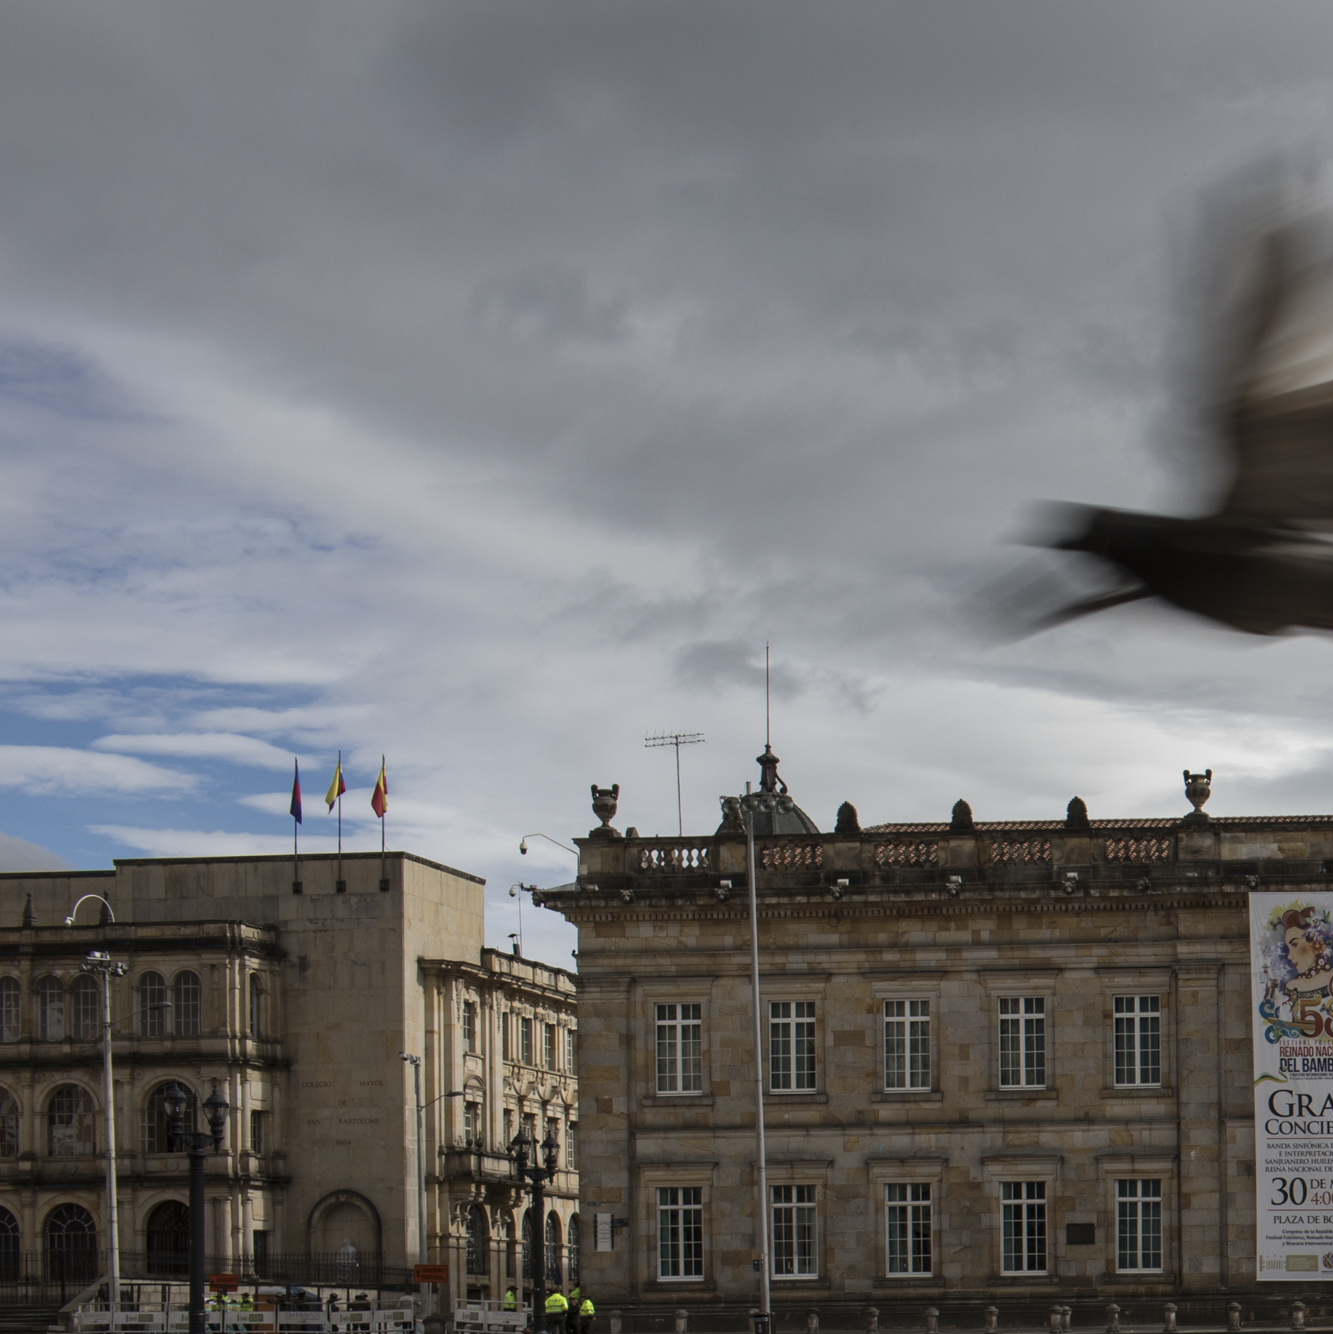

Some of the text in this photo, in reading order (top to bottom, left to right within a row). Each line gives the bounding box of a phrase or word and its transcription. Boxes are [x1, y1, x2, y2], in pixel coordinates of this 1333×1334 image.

[1279, 1046, 1314, 1057] REINADO
[1280, 1058, 1300, 1073] DEL
[1292, 1141, 1329, 1149] SINFÓNICA
[1271, 1177, 1307, 1206] 30
[1310, 1179, 1326, 1189] DE
[1273, 1215, 1304, 1224] PLAZA
[1307, 1215, 1321, 1224] DE
